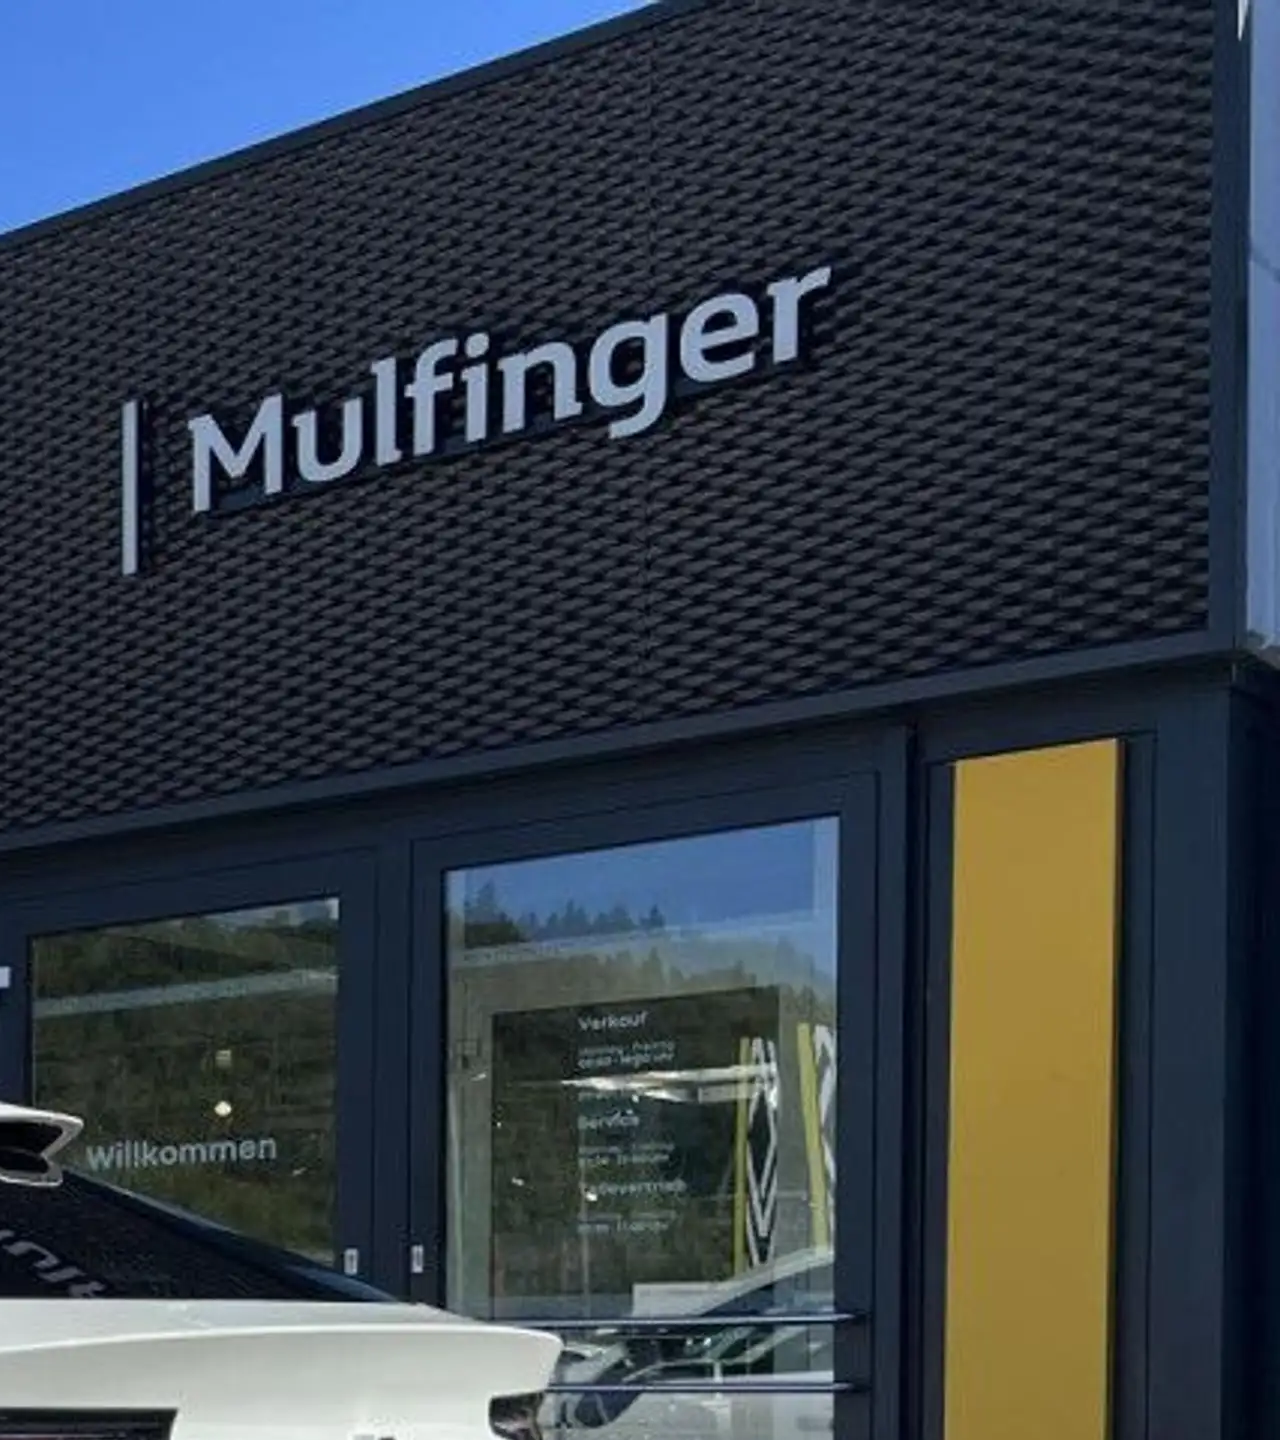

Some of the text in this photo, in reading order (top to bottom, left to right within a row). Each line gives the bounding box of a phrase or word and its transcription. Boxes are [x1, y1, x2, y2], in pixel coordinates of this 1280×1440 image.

[187, 265, 832, 513] Mulfinger
[577, 1010, 649, 1031] Verkauf
[85, 1135, 278, 1171] Willkommen
